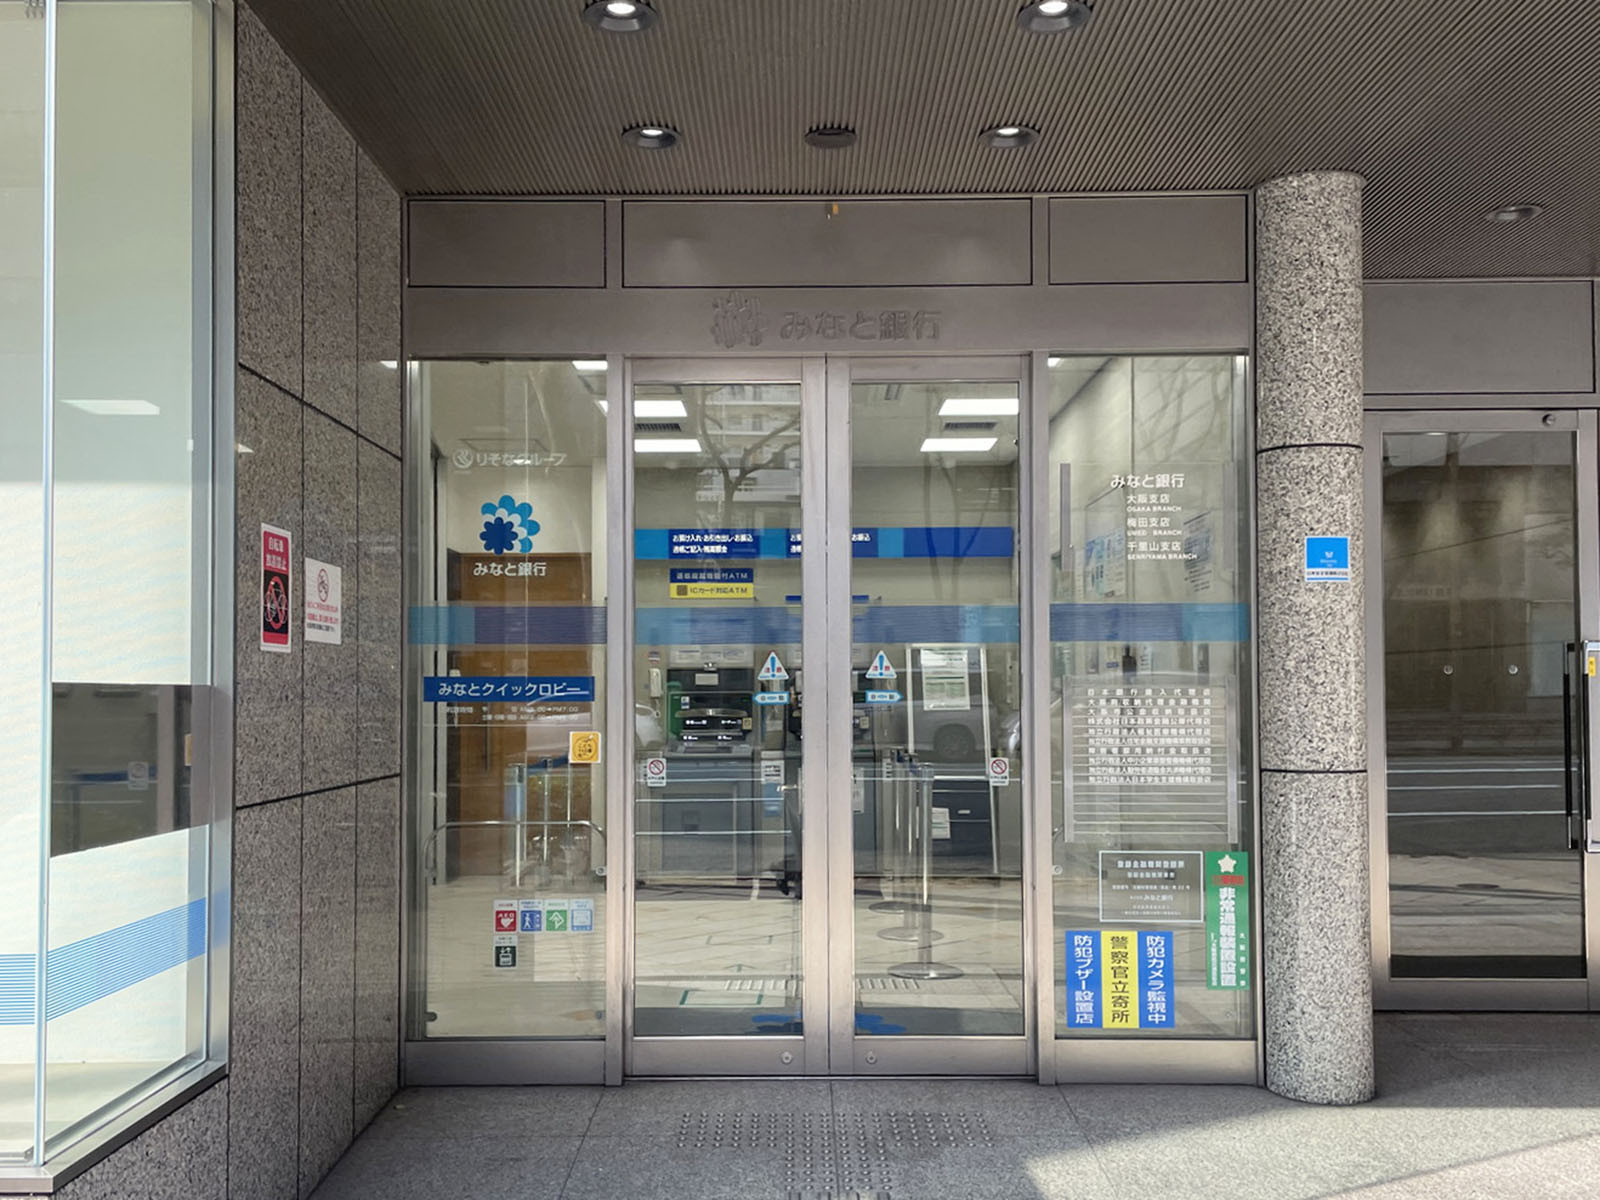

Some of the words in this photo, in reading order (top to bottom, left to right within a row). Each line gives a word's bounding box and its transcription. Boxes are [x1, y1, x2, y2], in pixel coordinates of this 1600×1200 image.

[780, 311, 943, 341] みなと銀行
[1110, 473, 1185, 489] みなと銀行
[1126, 494, 1170, 505] 大阪支店
[1126, 517, 1170, 528] 梅田支店
[1152, 529, 1182, 537] BRANCH
[1127, 541, 1181, 552] 千里山支店
[1127, 553, 1167, 561] SENRIYAMA
[1168, 552, 1198, 560] BRANCH
[473, 562, 547, 577] みなと銀行
[438, 682, 581, 697] みなとクイックロビー
[1074, 935, 1094, 1024] 防犯ブザー設置店
[1110, 936, 1129, 1023] 警察官立寄所
[1146, 935, 1167, 1025] 防犯カメラ監視中
